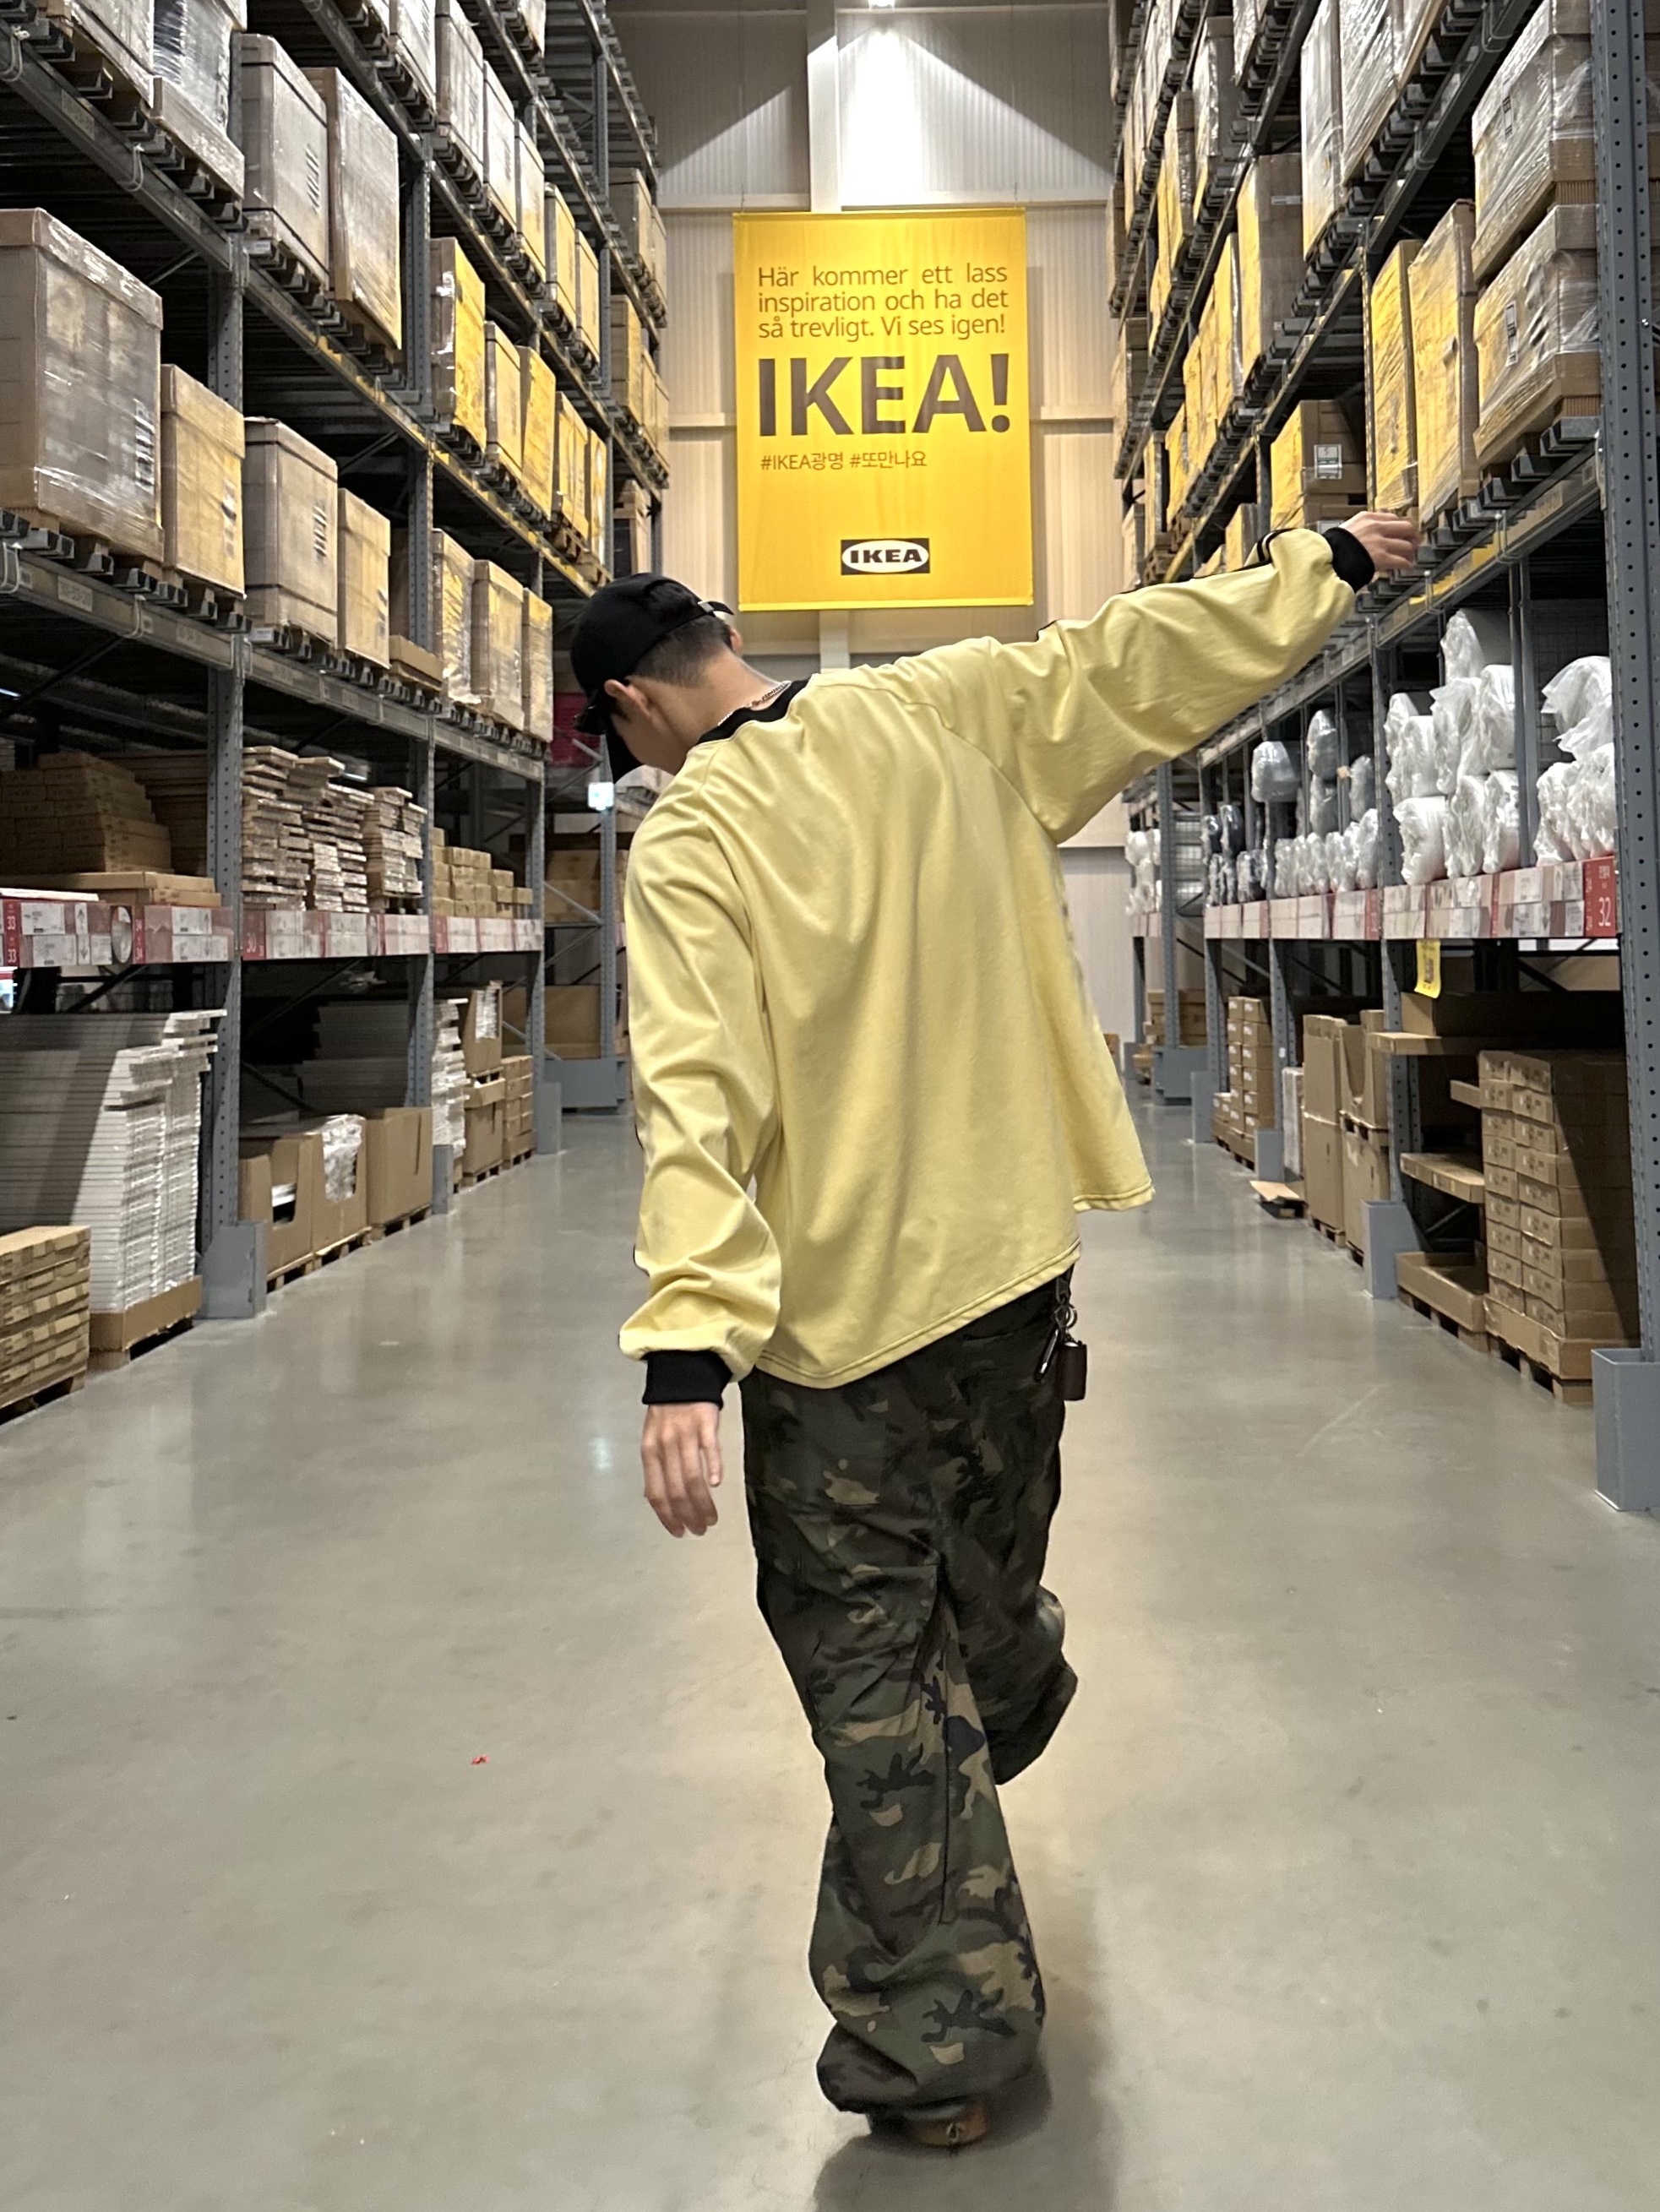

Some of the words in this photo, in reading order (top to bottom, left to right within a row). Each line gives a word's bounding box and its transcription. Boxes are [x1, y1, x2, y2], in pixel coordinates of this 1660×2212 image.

[759, 267, 799, 287] Här
[813, 265, 908, 285] kommer
[922, 265, 953, 284] ett
[966, 263, 1008, 283] lass
[759, 291, 875, 318] inspiration
[885, 289, 924, 311] och
[934, 289, 961, 309] ha
[972, 287, 1009, 308] det
[759, 316, 783, 338] så
[790, 316, 874, 342] trevligt.
[881, 315, 901, 336] Vi
[908, 318, 944, 335] ses
[951, 313, 1005, 340] igen!
[759, 353, 1010, 437] IKEA!
[760, 451, 844, 471] #IKEA광명
[849, 450, 928, 469] #또만나요
[851, 549, 923, 563] IKEA
[1598, 897, 1611, 927] 32
